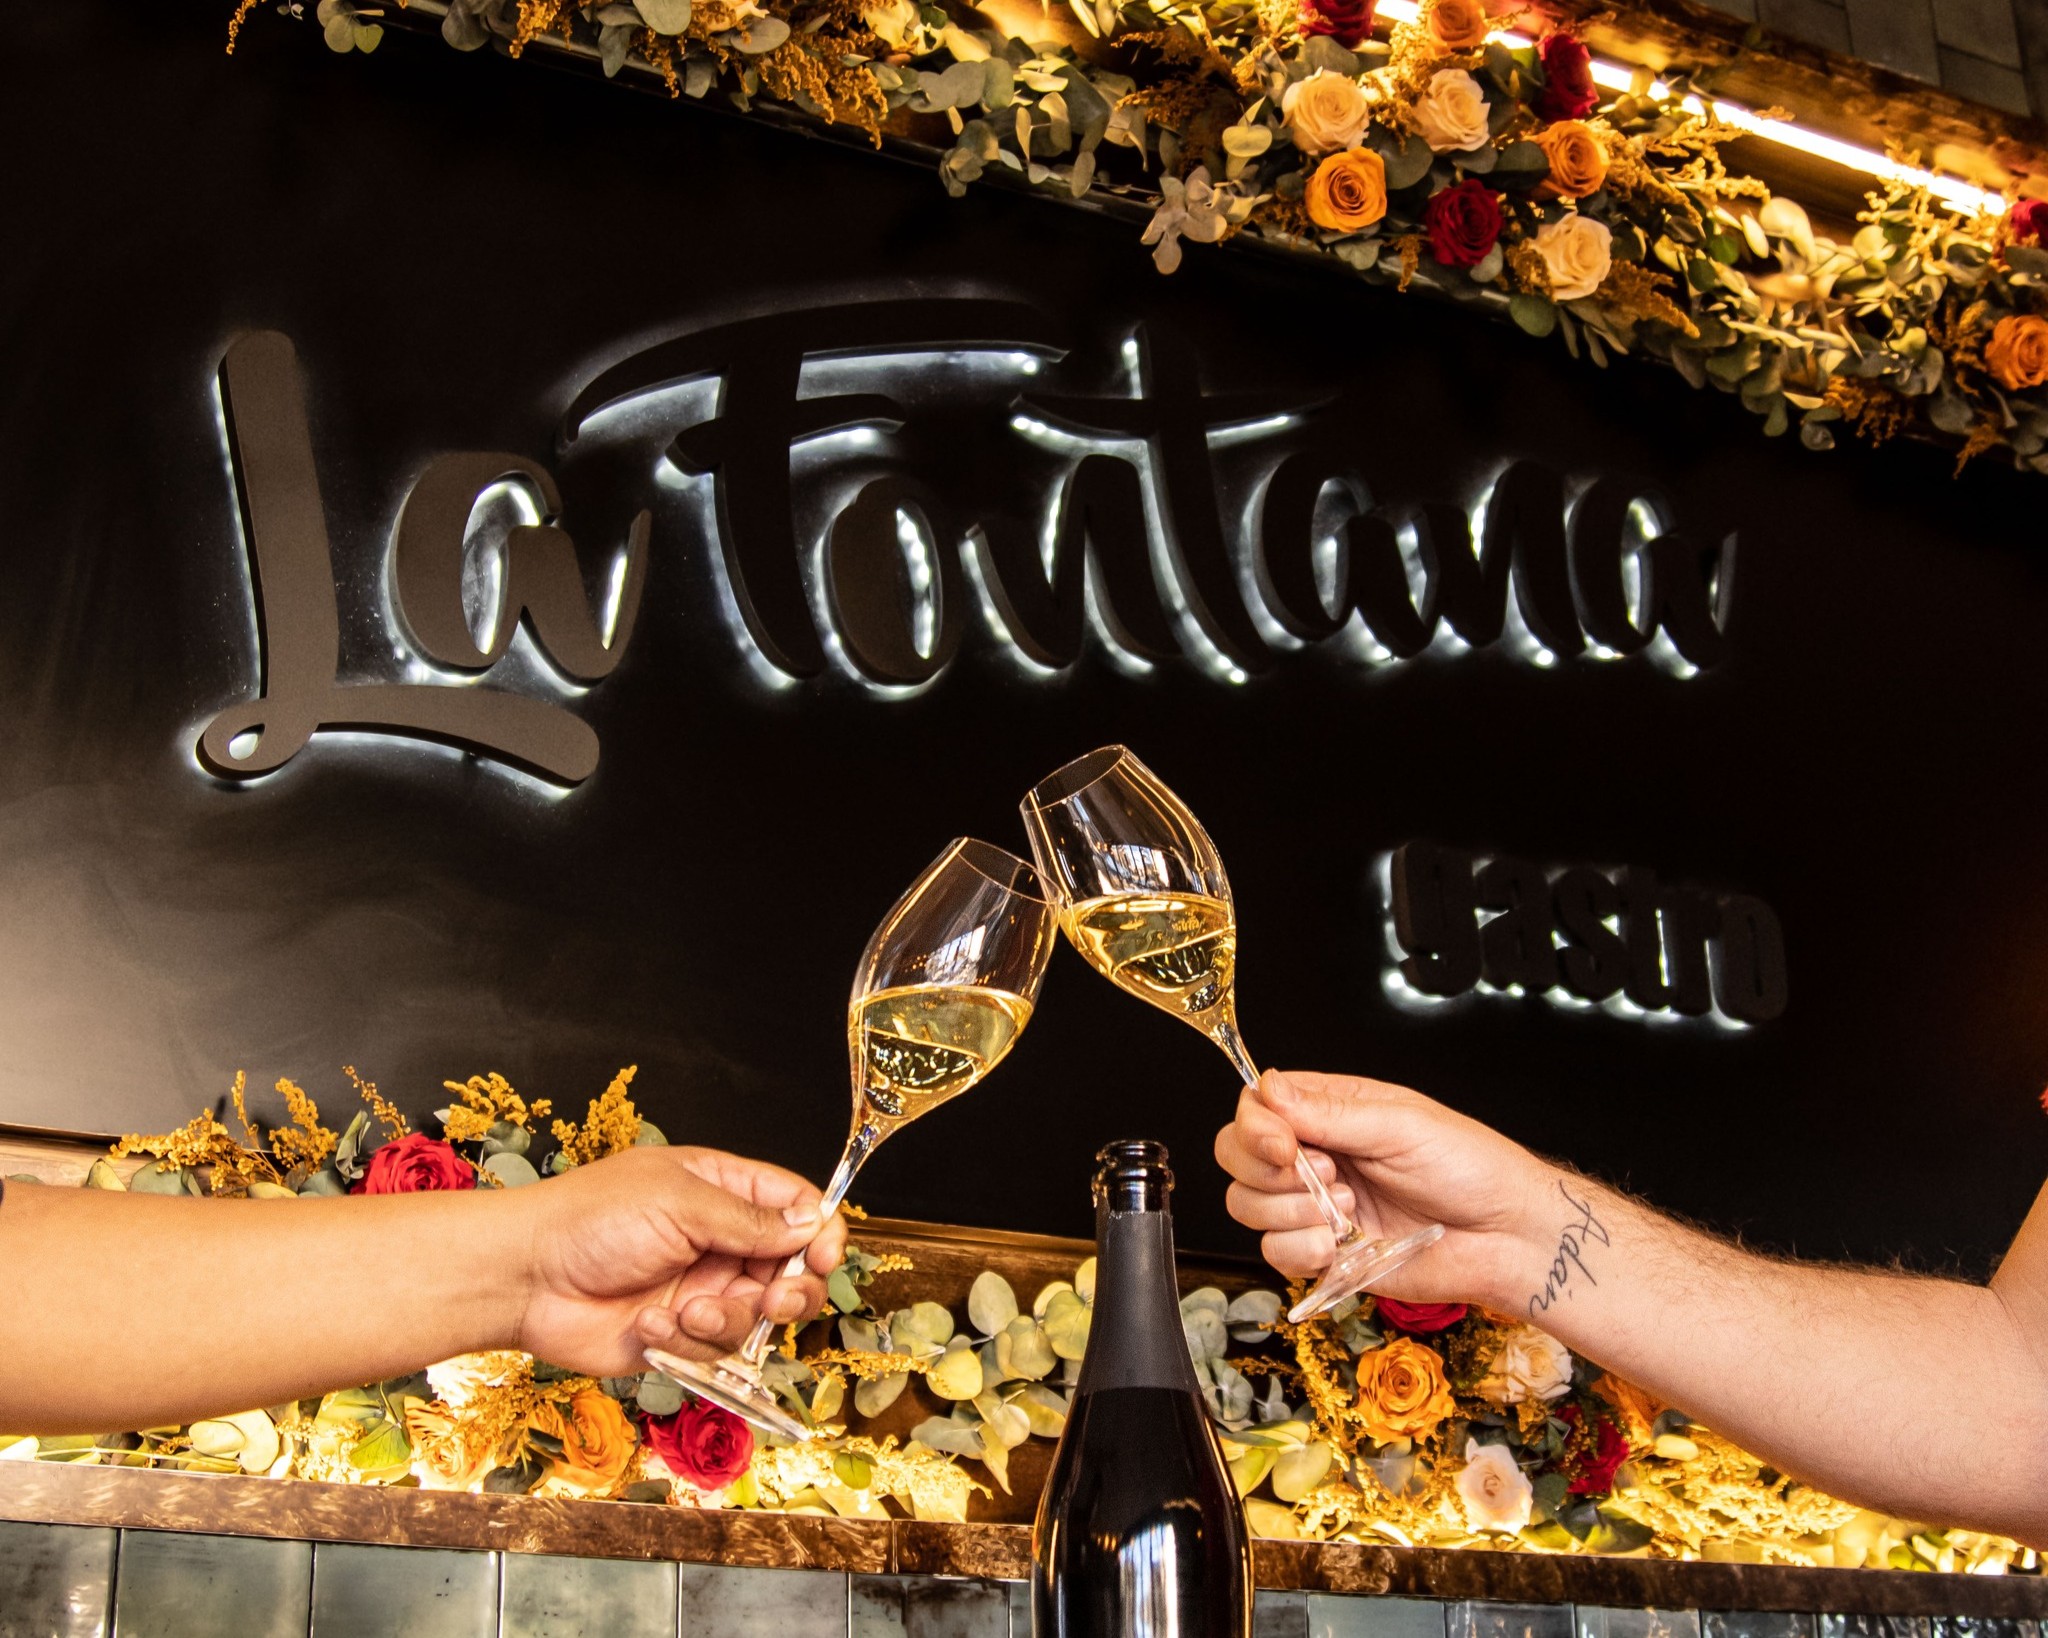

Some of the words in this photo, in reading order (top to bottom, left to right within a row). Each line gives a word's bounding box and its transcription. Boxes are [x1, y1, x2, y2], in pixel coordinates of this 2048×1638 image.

[195, 328, 652, 786] La
[558, 297, 1738, 686] Fontana
[1385, 841, 1788, 1027] gastro
